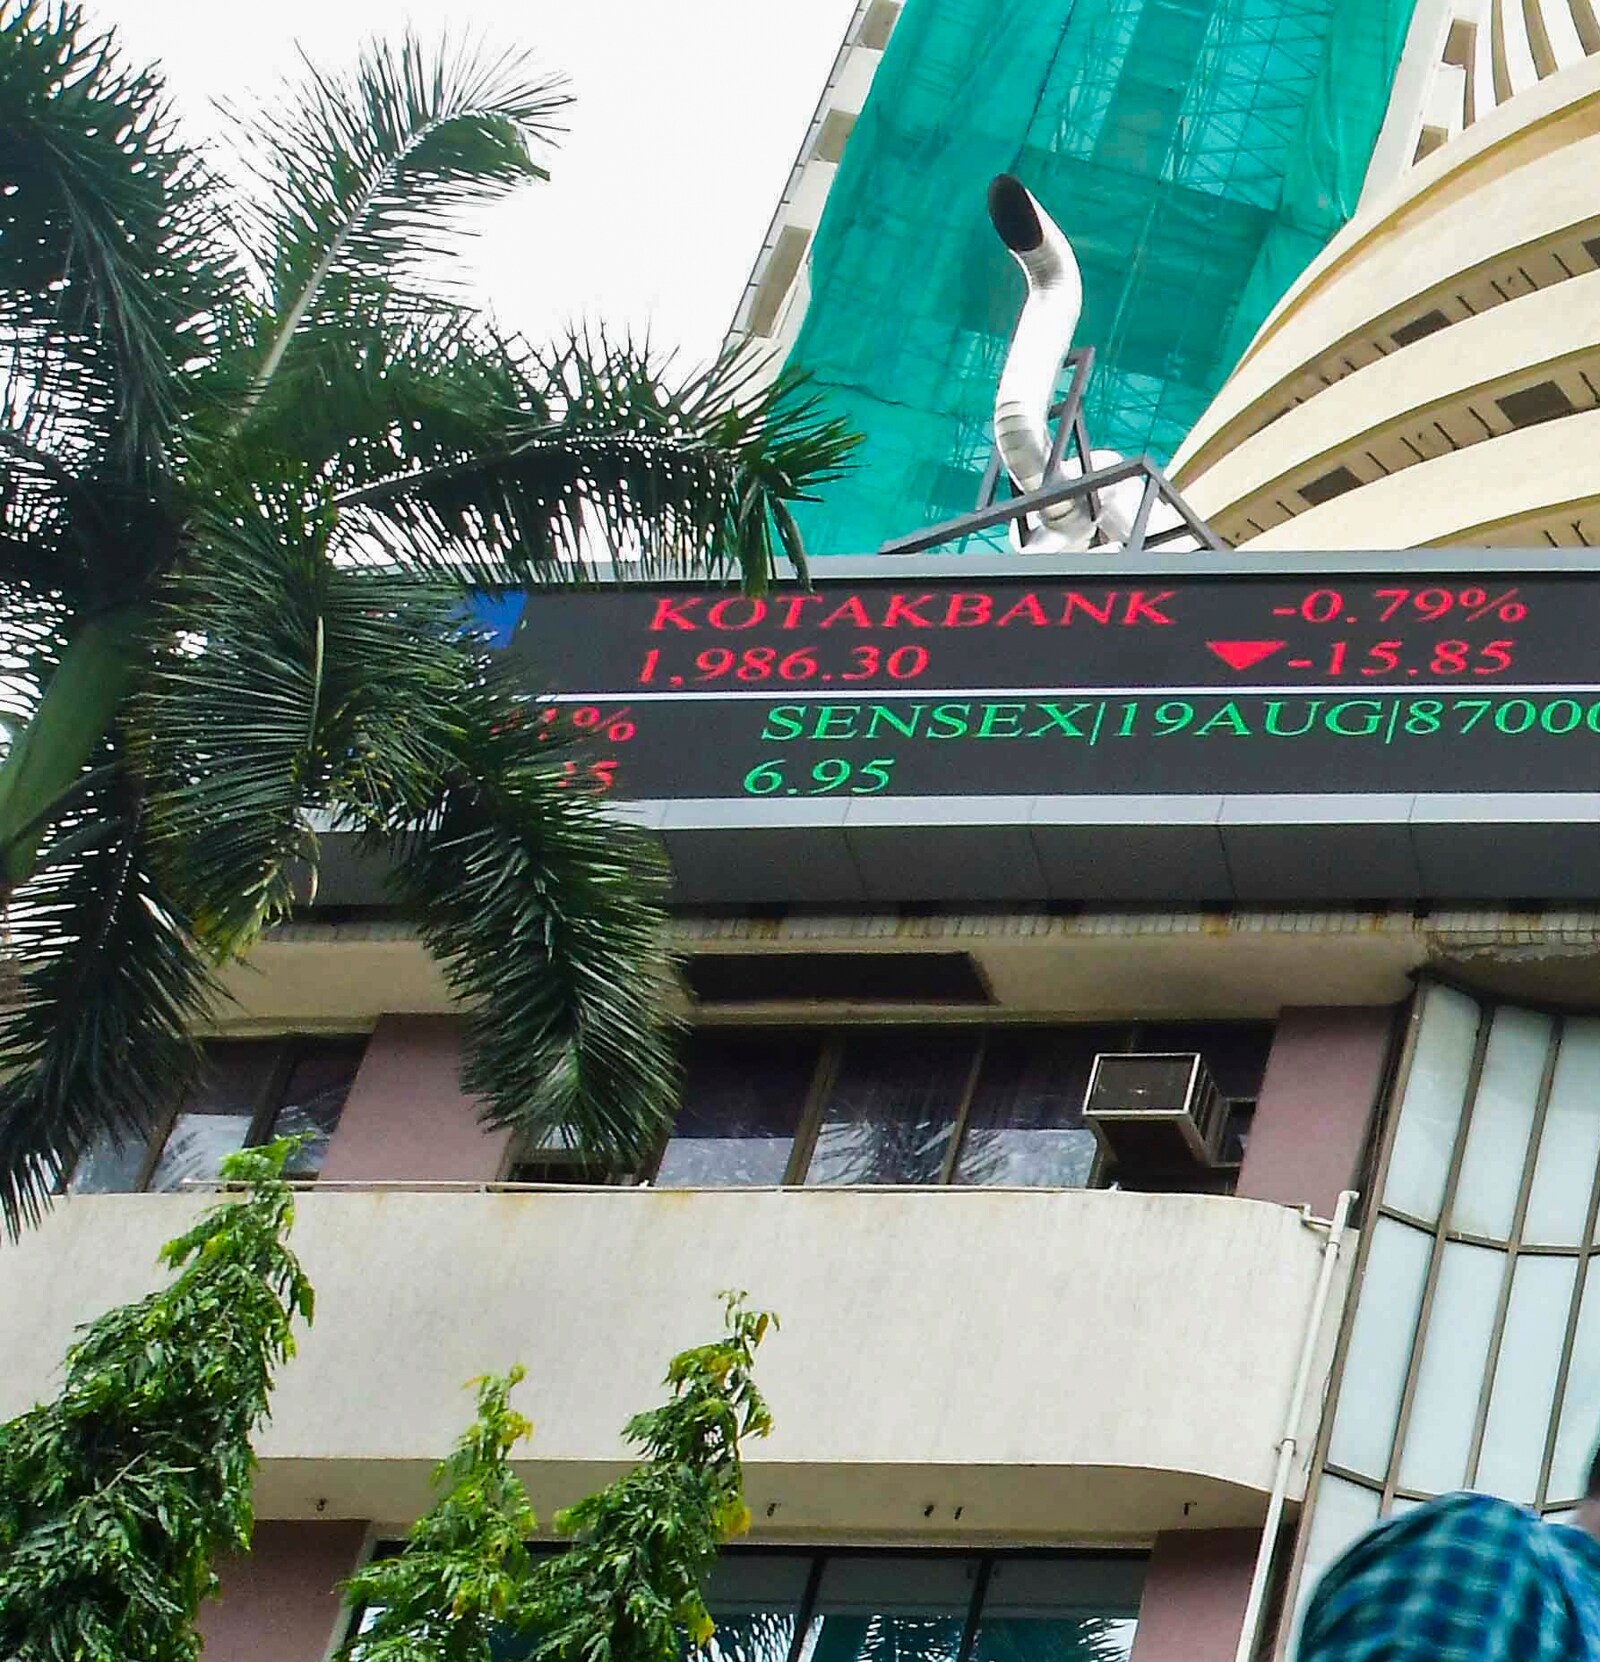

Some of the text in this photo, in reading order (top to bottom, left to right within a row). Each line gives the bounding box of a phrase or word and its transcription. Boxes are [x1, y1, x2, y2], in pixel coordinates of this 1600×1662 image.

[649, 588, 1528, 632] KOTAKBANK -0.79%
[637, 639, 1515, 687] 1,986.30 -15.85
[742, 758, 896, 796] 6.95
